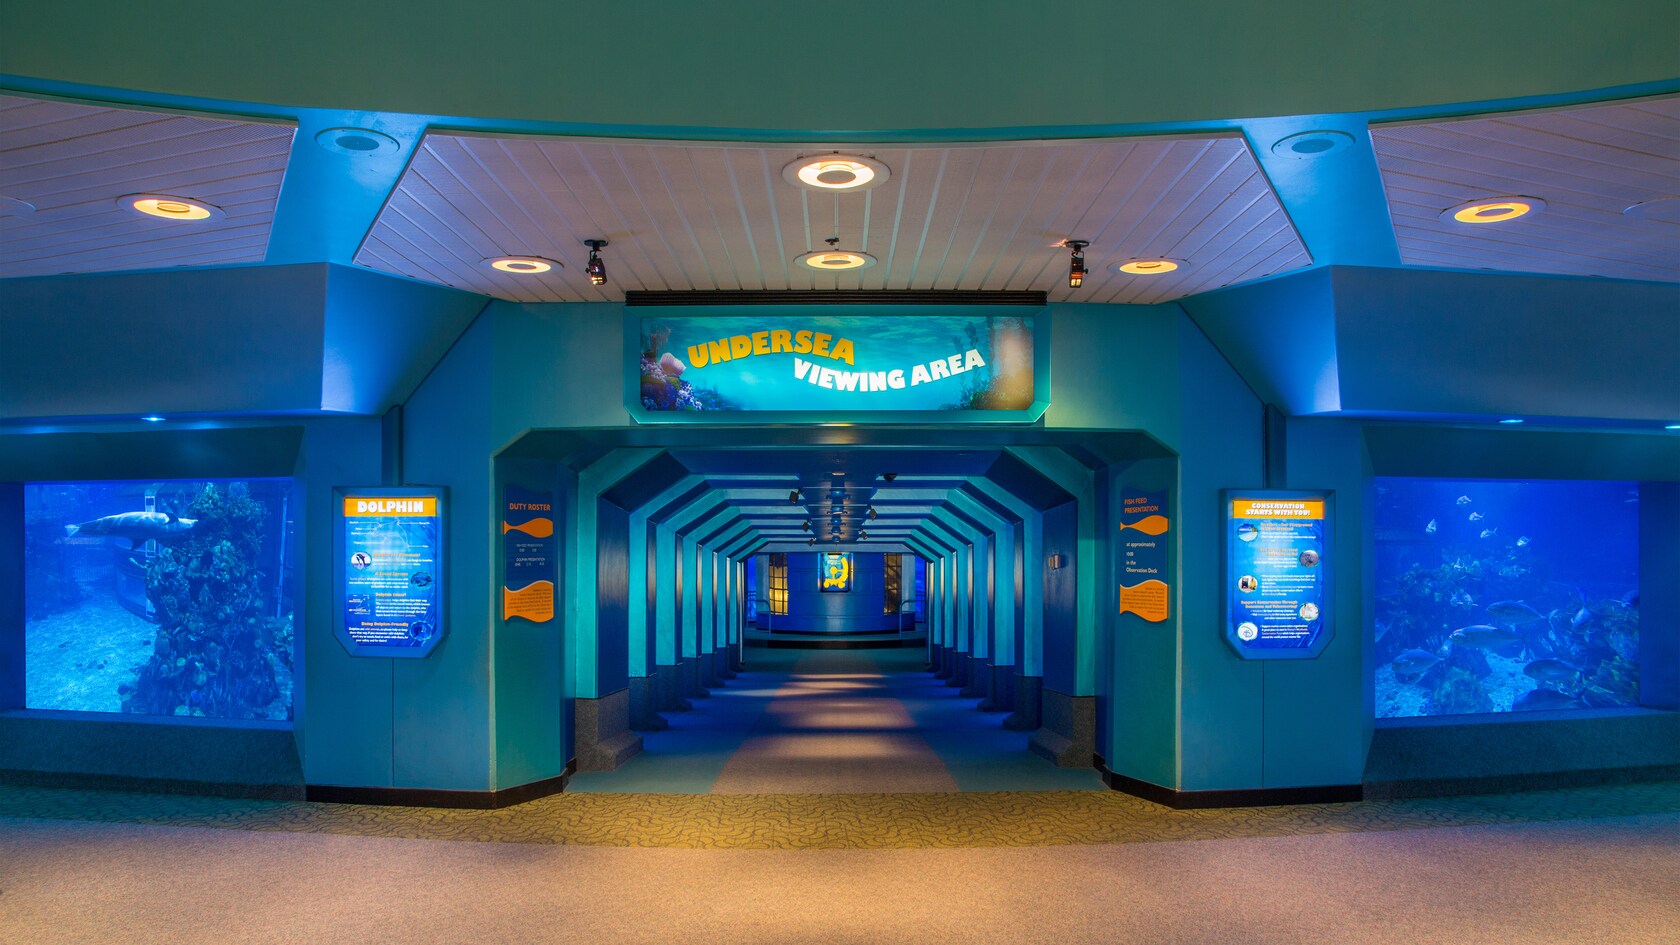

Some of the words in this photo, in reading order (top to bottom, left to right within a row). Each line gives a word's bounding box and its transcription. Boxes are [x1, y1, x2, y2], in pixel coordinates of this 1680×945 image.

[687, 328, 856, 369] UNDERSEA
[793, 356, 906, 393] VIEWING
[910, 348, 986, 387] AREA
[357, 500, 424, 513] DOLPHIN
[509, 502, 527, 510] DUTY
[528, 503, 551, 511] ROSTER
[1124, 505, 1159, 513] PRESENTATION
